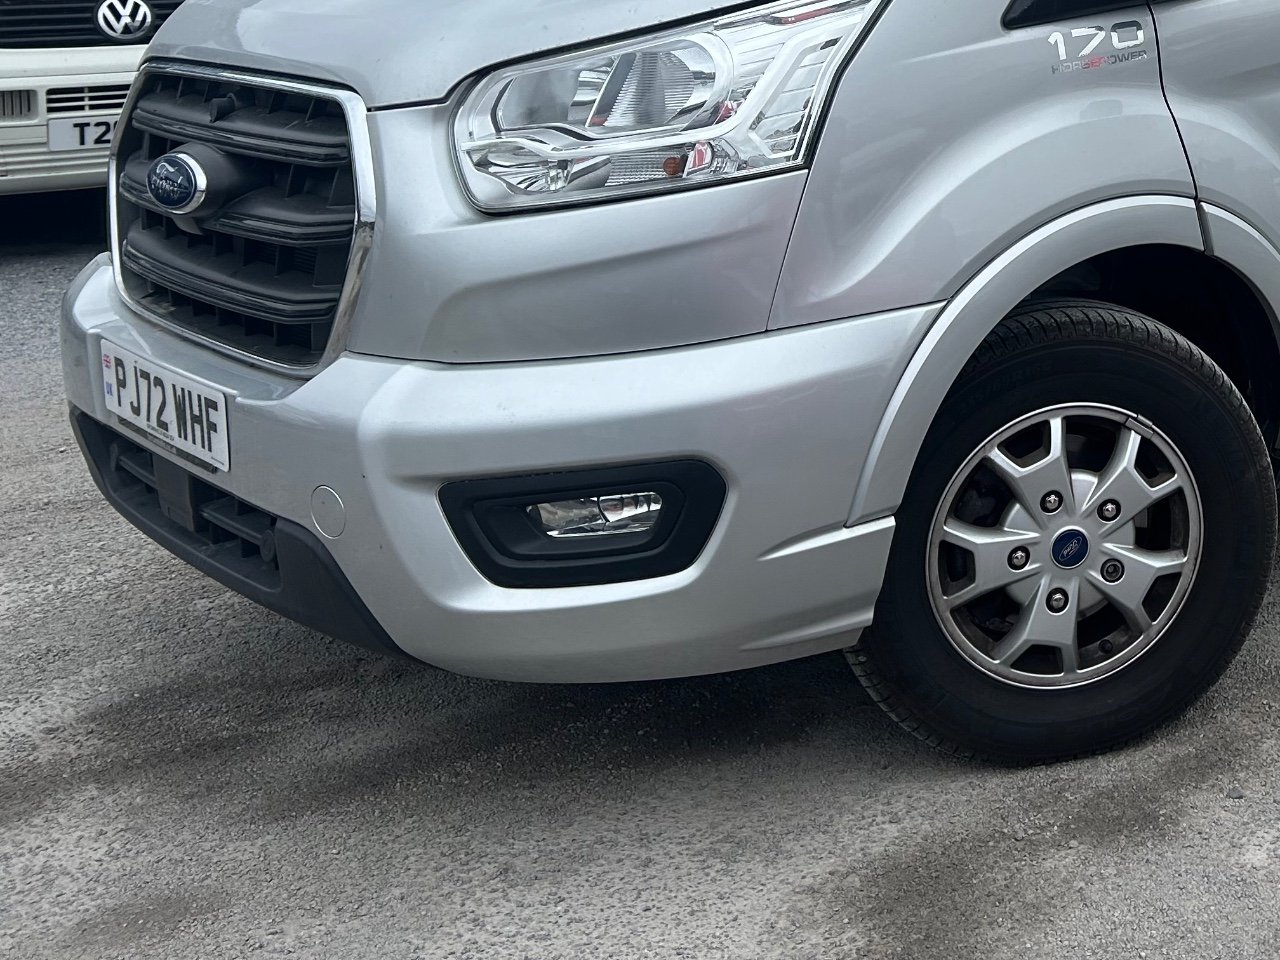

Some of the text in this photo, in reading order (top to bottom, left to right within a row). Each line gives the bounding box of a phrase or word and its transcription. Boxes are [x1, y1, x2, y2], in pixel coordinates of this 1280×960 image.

[1047, 20, 1145, 61] 170
[73, 121, 118, 145] T2
[114, 356, 219, 453] PJ72 WHF
